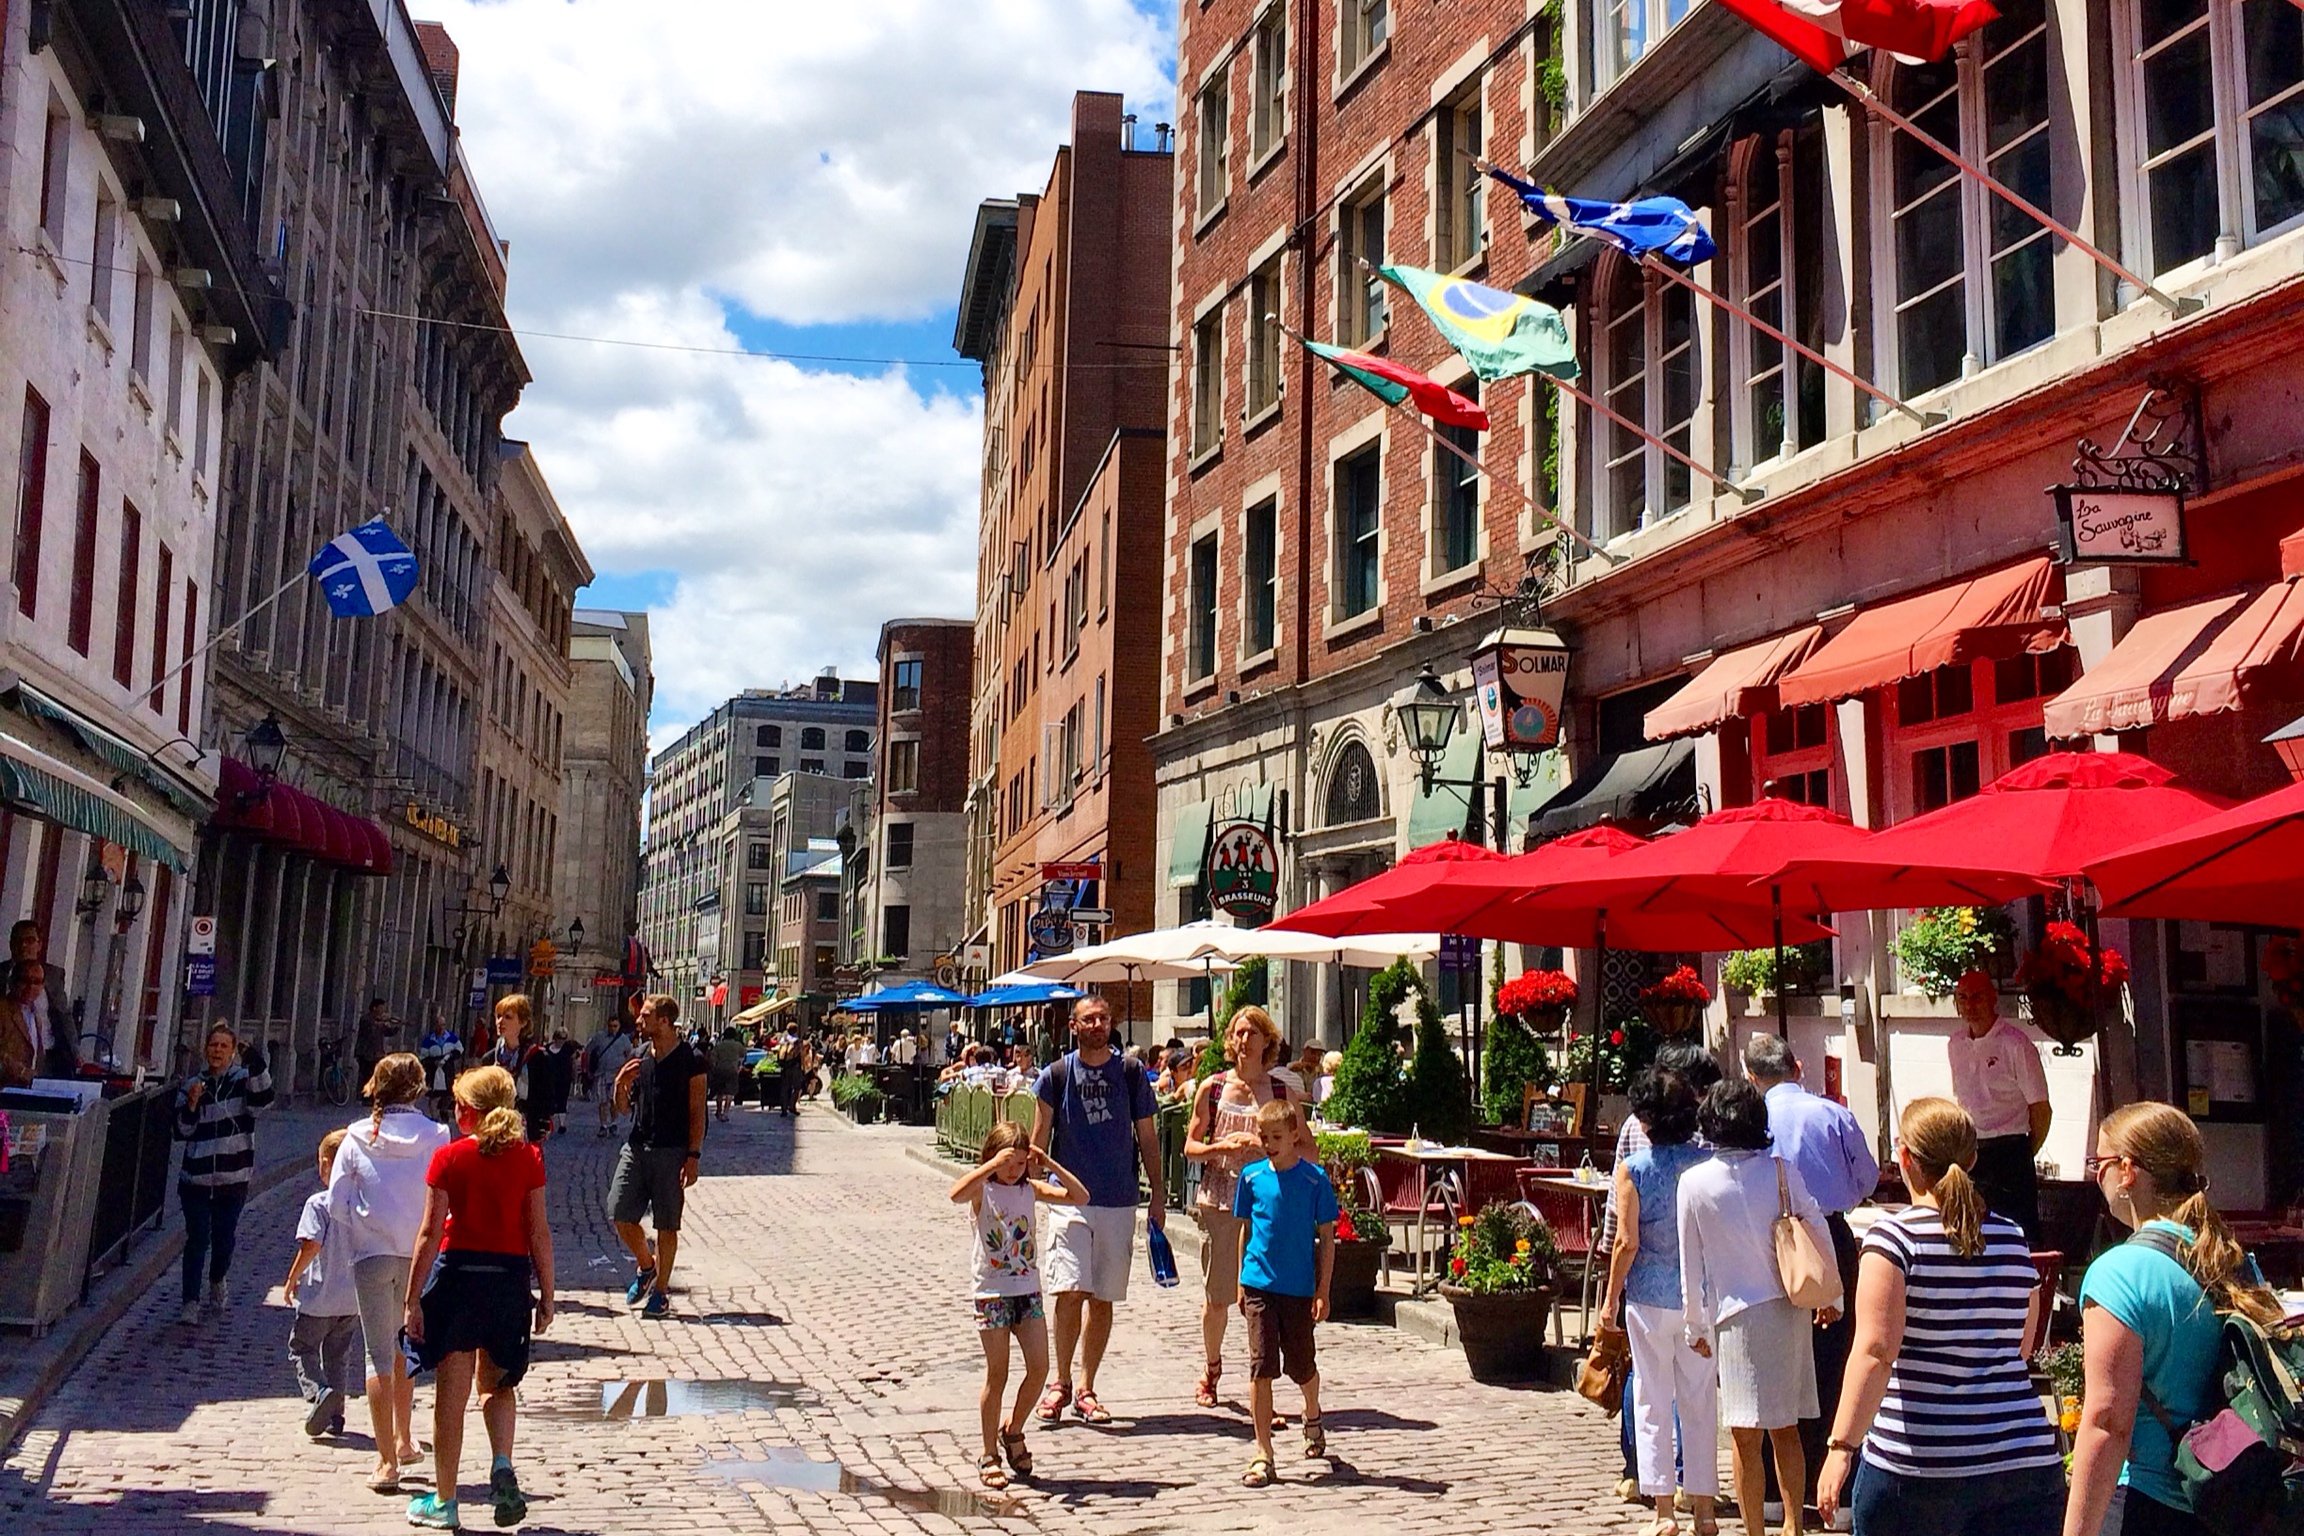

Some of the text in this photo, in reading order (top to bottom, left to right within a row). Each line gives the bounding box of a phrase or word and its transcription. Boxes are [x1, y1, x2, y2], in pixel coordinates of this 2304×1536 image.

[2076, 498, 2102, 520] La
[2078, 511, 2154, 543] Sauvagine
[1502, 647, 1567, 675] SOLMAR
[1241, 879, 1249, 889] 3
[1218, 892, 1273, 906] BRASSEURS
